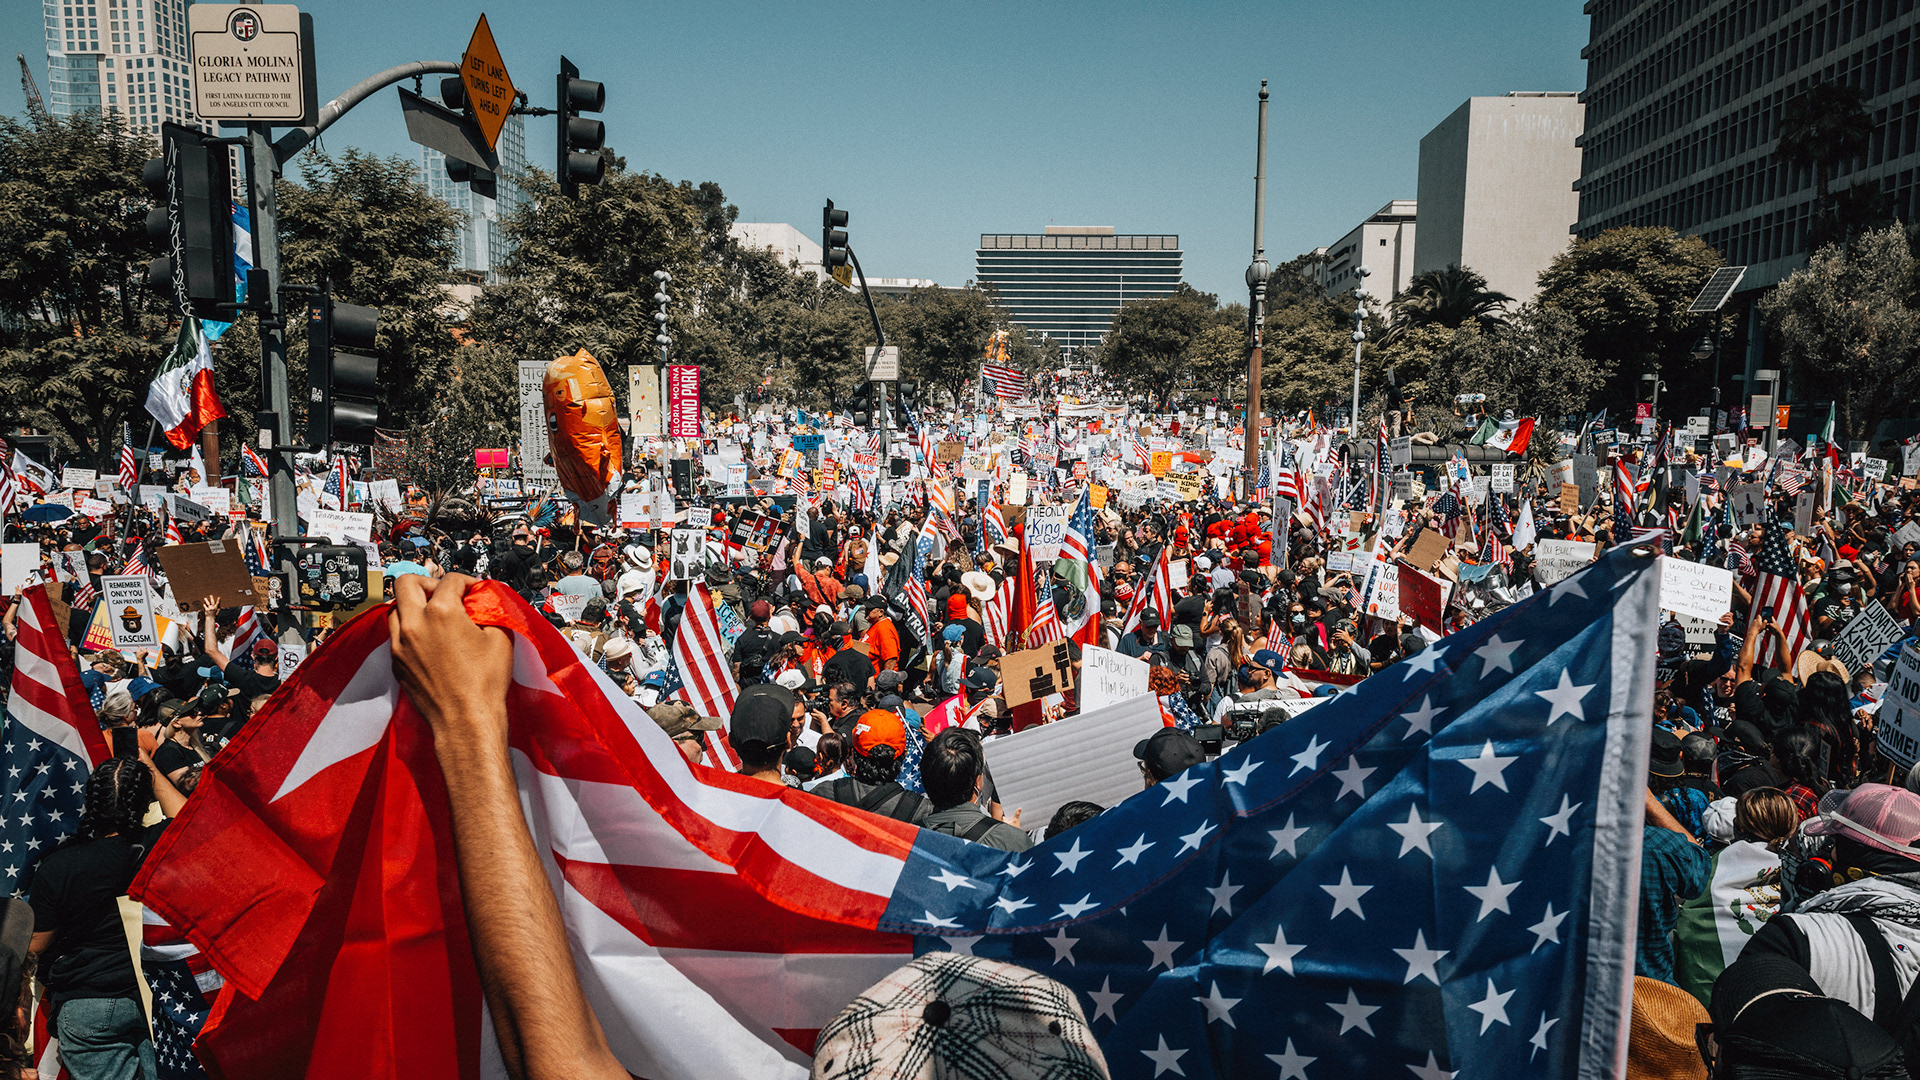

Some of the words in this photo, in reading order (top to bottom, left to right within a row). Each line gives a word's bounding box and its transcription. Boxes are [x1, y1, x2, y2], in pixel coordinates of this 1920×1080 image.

[198, 56, 243, 68] GLORIA
[247, 56, 294, 68] MOLINA
[470, 56, 485, 74] LEFT
[487, 63, 504, 81] LANE
[203, 72, 242, 82] LEGACY
[246, 72, 291, 82] PATHWAY
[469, 74, 490, 94] TURNS
[492, 84, 506, 100] LEFT
[479, 98, 500, 116] AHEAD
[672, 366, 680, 400] MOLINA
[681, 368, 698, 396] PARK
[672, 403, 680, 435] GLORIA
[681, 399, 698, 435] GRAND
[1036, 443, 1058, 452] LOYALTY
[904, 462, 909, 473] 3
[1165, 471, 1185, 480] THERE
[1550, 464, 1571, 476] CHINGA
[1028, 507, 1045, 518] THE
[1045, 506, 1067, 518] ONLY
[1032, 518, 1060, 539] King
[1028, 534, 1042, 546] IS
[1043, 533, 1065, 545] God
[1542, 545, 1553, 555] YOU
[1555, 546, 1575, 556] BUILT
[1540, 558, 1556, 568] YOUR
[1540, 570, 1554, 580] ON
[1664, 572, 1681, 584] BE
[1690, 578, 1727, 594] OVER
[1379, 581, 1397, 594] LOVE
[556, 594, 580, 606] STOP
[716, 602, 734, 625] ICE
[731, 615, 741, 626] OUT
[1864, 600, 1903, 644] LUNATIC
[86, 634, 95, 642] IS
[89, 624, 112, 639] HUM
[119, 635, 152, 643] FASCISM
[721, 628, 736, 645] LA
[1854, 616, 1888, 654] FAUX
[1844, 626, 1874, 663] KING
[1890, 669, 1901, 692] IS
[1894, 708, 1902, 728] A
[1879, 718, 1919, 760] CRIME!
